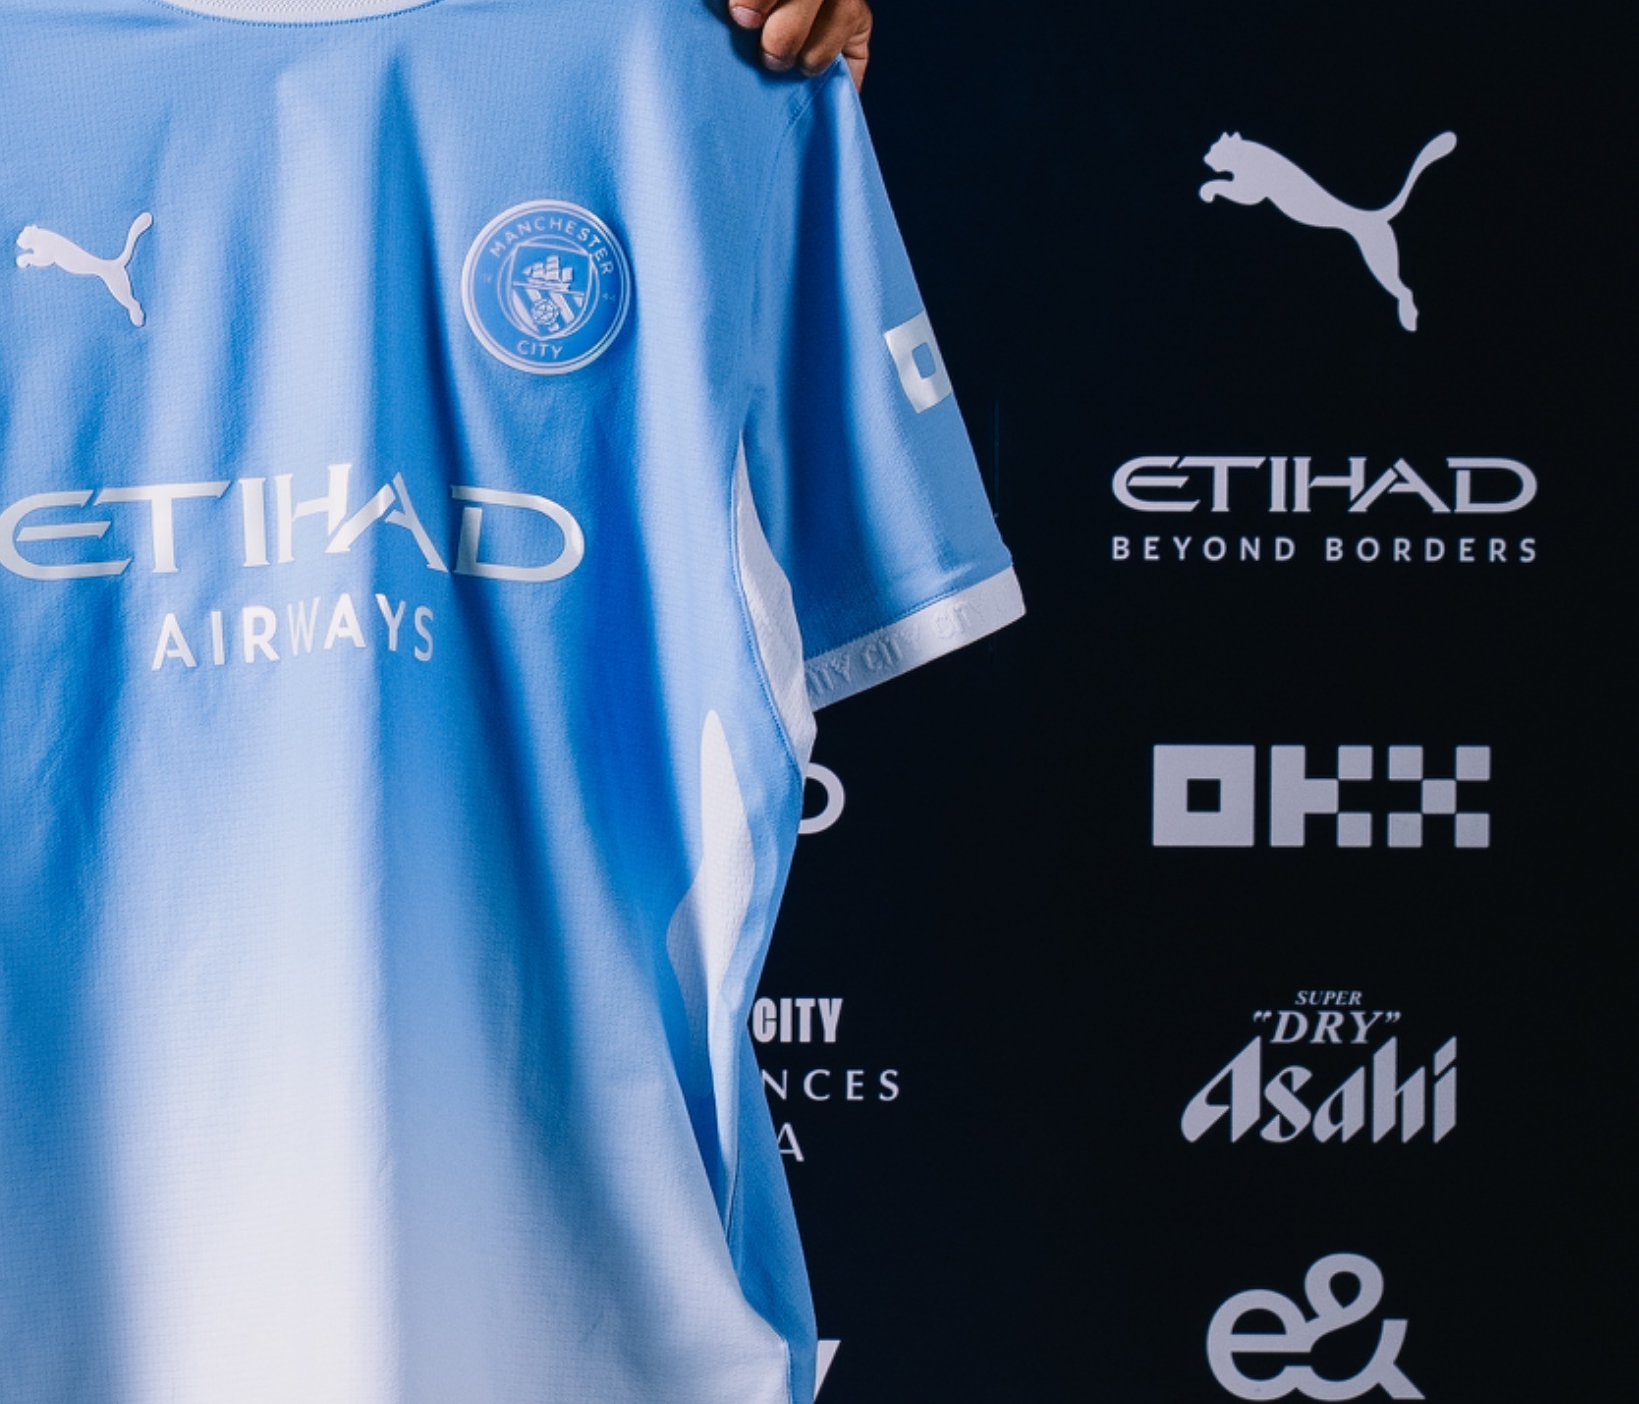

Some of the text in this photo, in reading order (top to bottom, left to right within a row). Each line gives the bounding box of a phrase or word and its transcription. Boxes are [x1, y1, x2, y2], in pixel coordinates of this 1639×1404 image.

[489, 216, 613, 275] MANCHESTER
[517, 340, 563, 359] CITY
[1111, 455, 1538, 514] ETIHAD
[1111, 535, 1536, 563] BEYOND BORDERS
[151, 592, 435, 671] AIRWAYS
[1152, 744, 1491, 848] OKX
[752, 997, 844, 1044] CITY
[1295, 990, 1362, 1006] SUPER
[1180, 1035, 1457, 1144] Asahi
